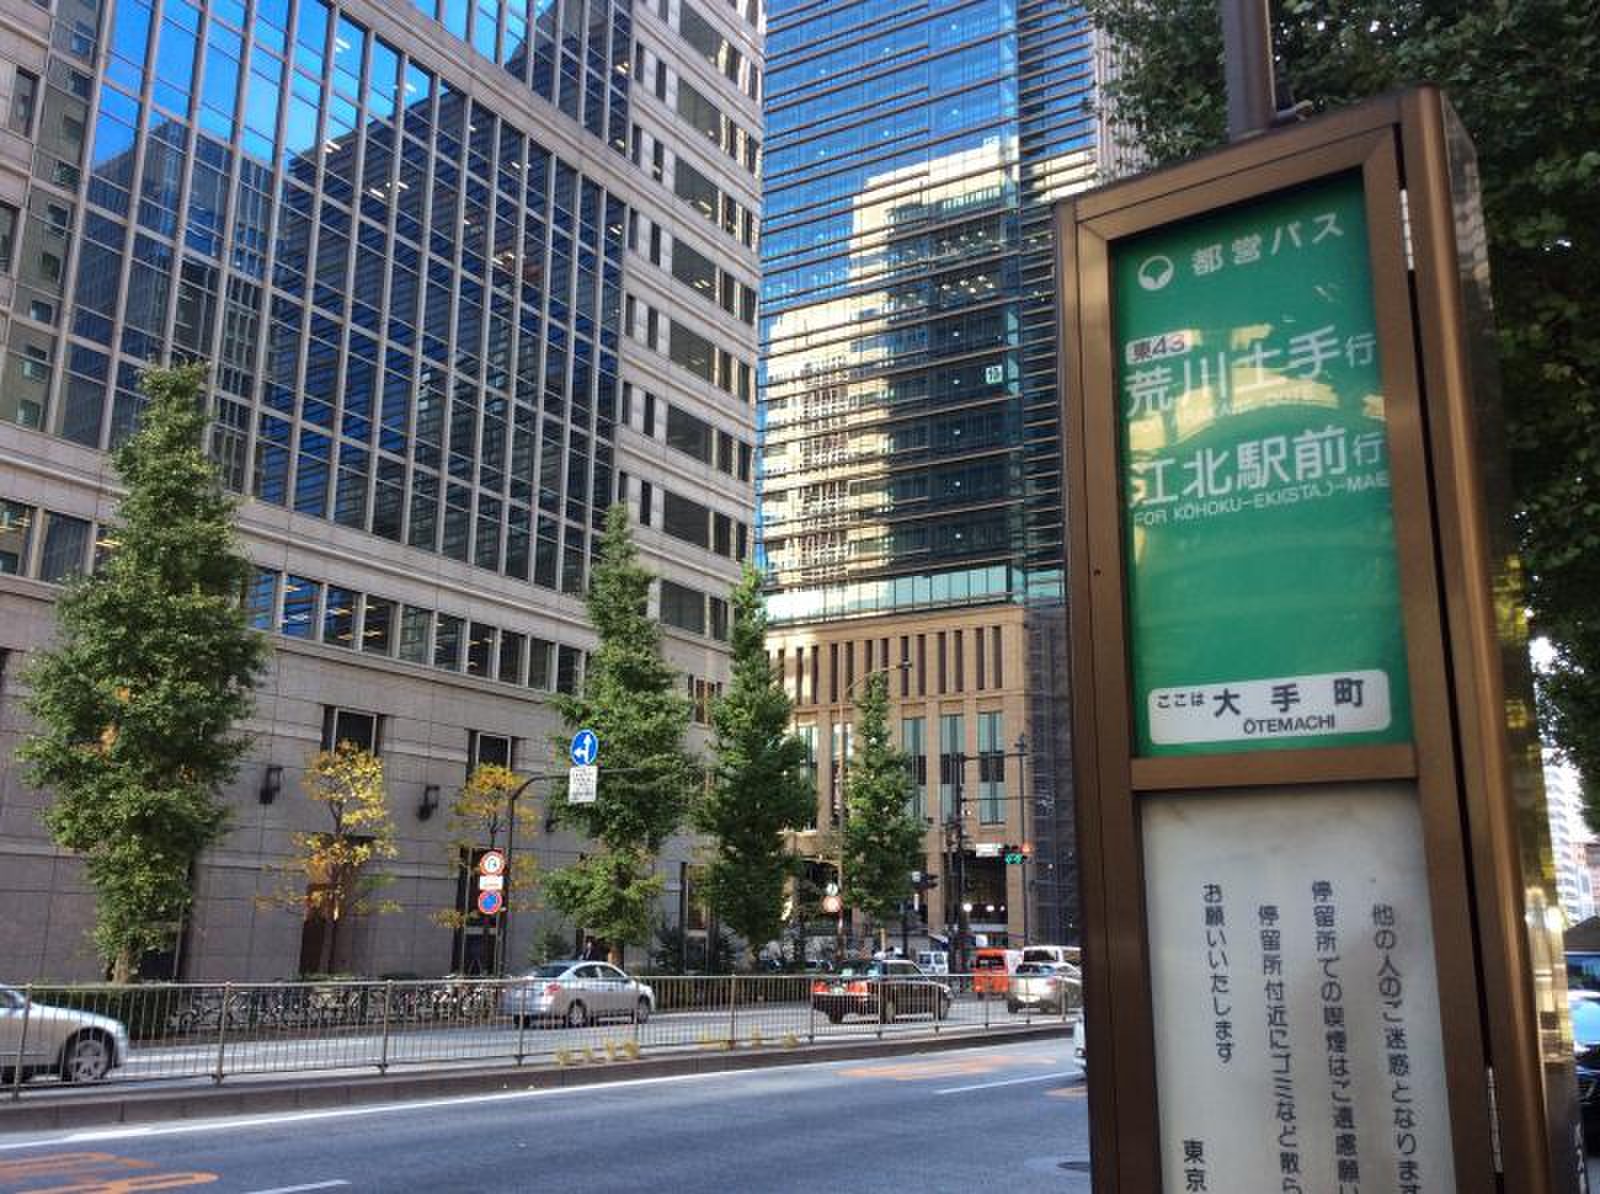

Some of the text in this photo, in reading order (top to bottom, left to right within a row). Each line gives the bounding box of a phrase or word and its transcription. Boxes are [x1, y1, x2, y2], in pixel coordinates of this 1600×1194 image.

[1191, 213, 1344, 276] 都営バス
[1156, 691, 1205, 709] ここは
[1242, 714, 1336, 735] OTEMACHI
[1202, 883, 1234, 1066] お願いいたします
